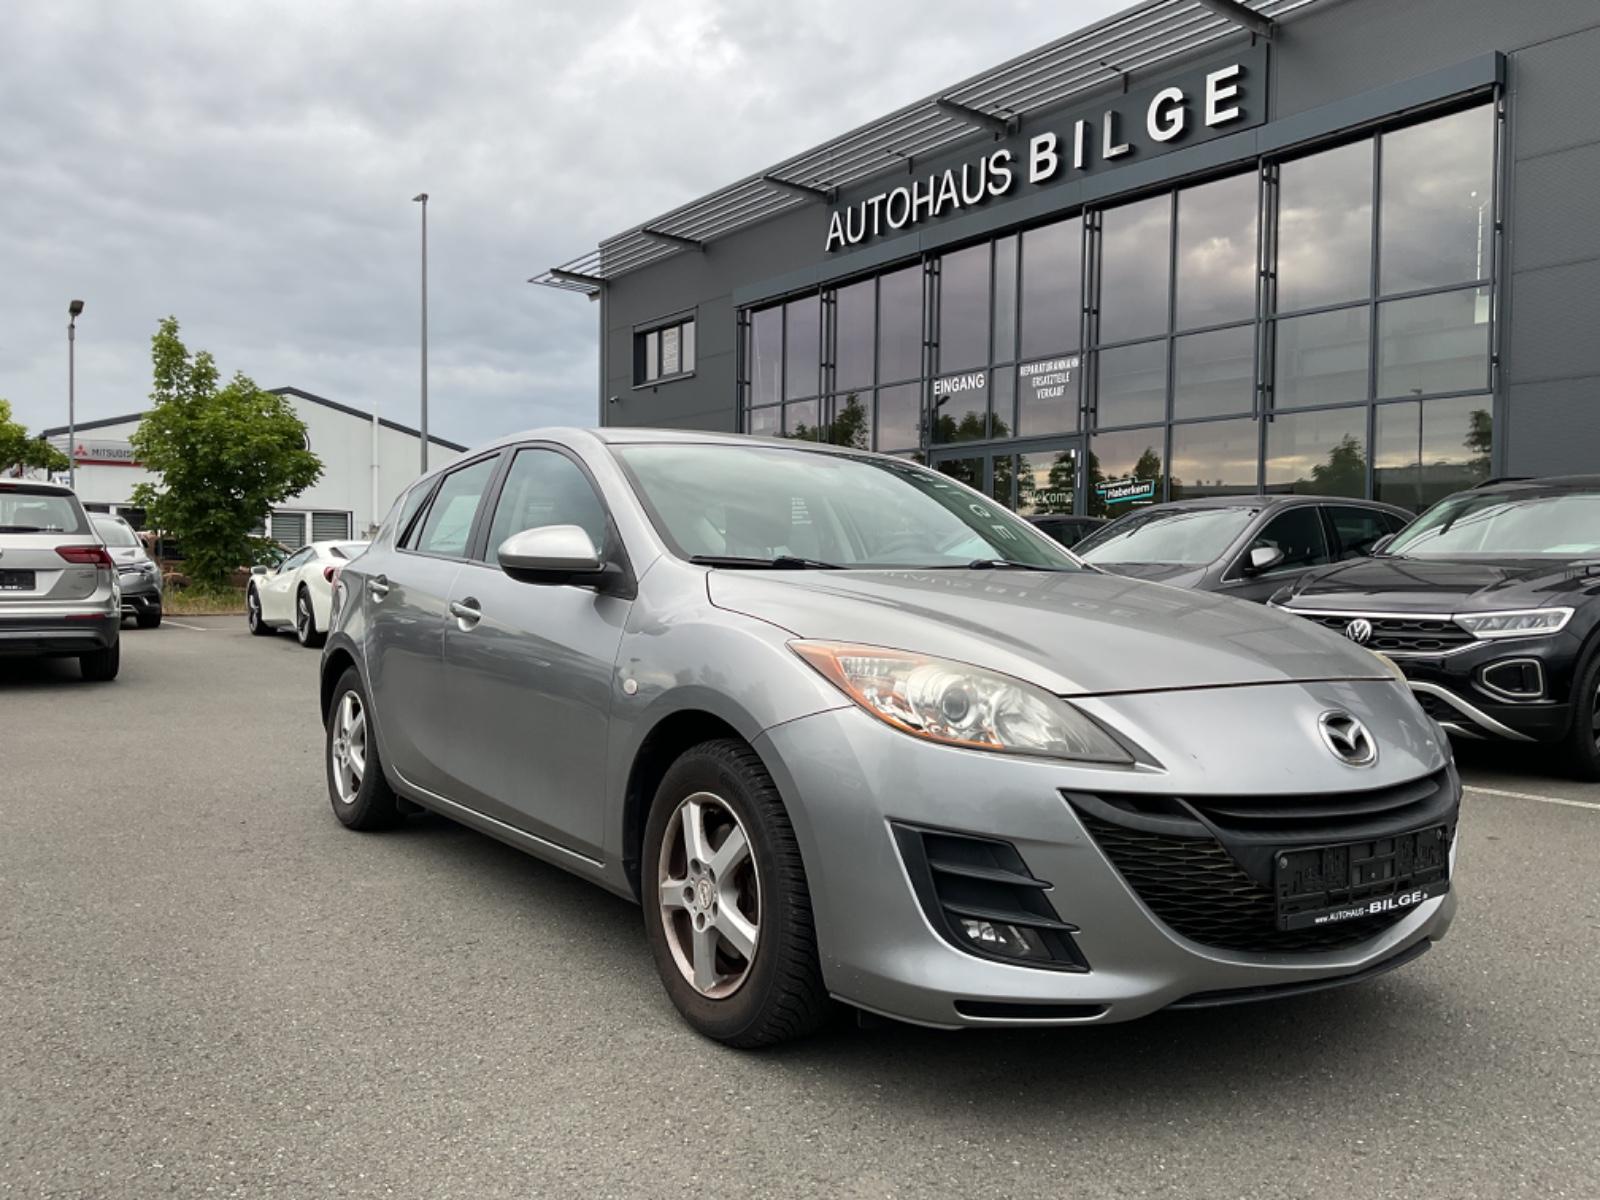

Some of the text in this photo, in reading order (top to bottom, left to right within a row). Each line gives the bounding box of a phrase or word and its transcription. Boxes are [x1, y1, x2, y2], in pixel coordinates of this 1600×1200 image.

[825, 64, 1240, 252] AUTOHAUS BILGE
[934, 373, 985, 395] EINGANG
[1032, 371, 1070, 388] ERSATZTEILE
[1036, 385, 1065, 400] VERKAUF
[1107, 484, 1150, 499] Haberkern
